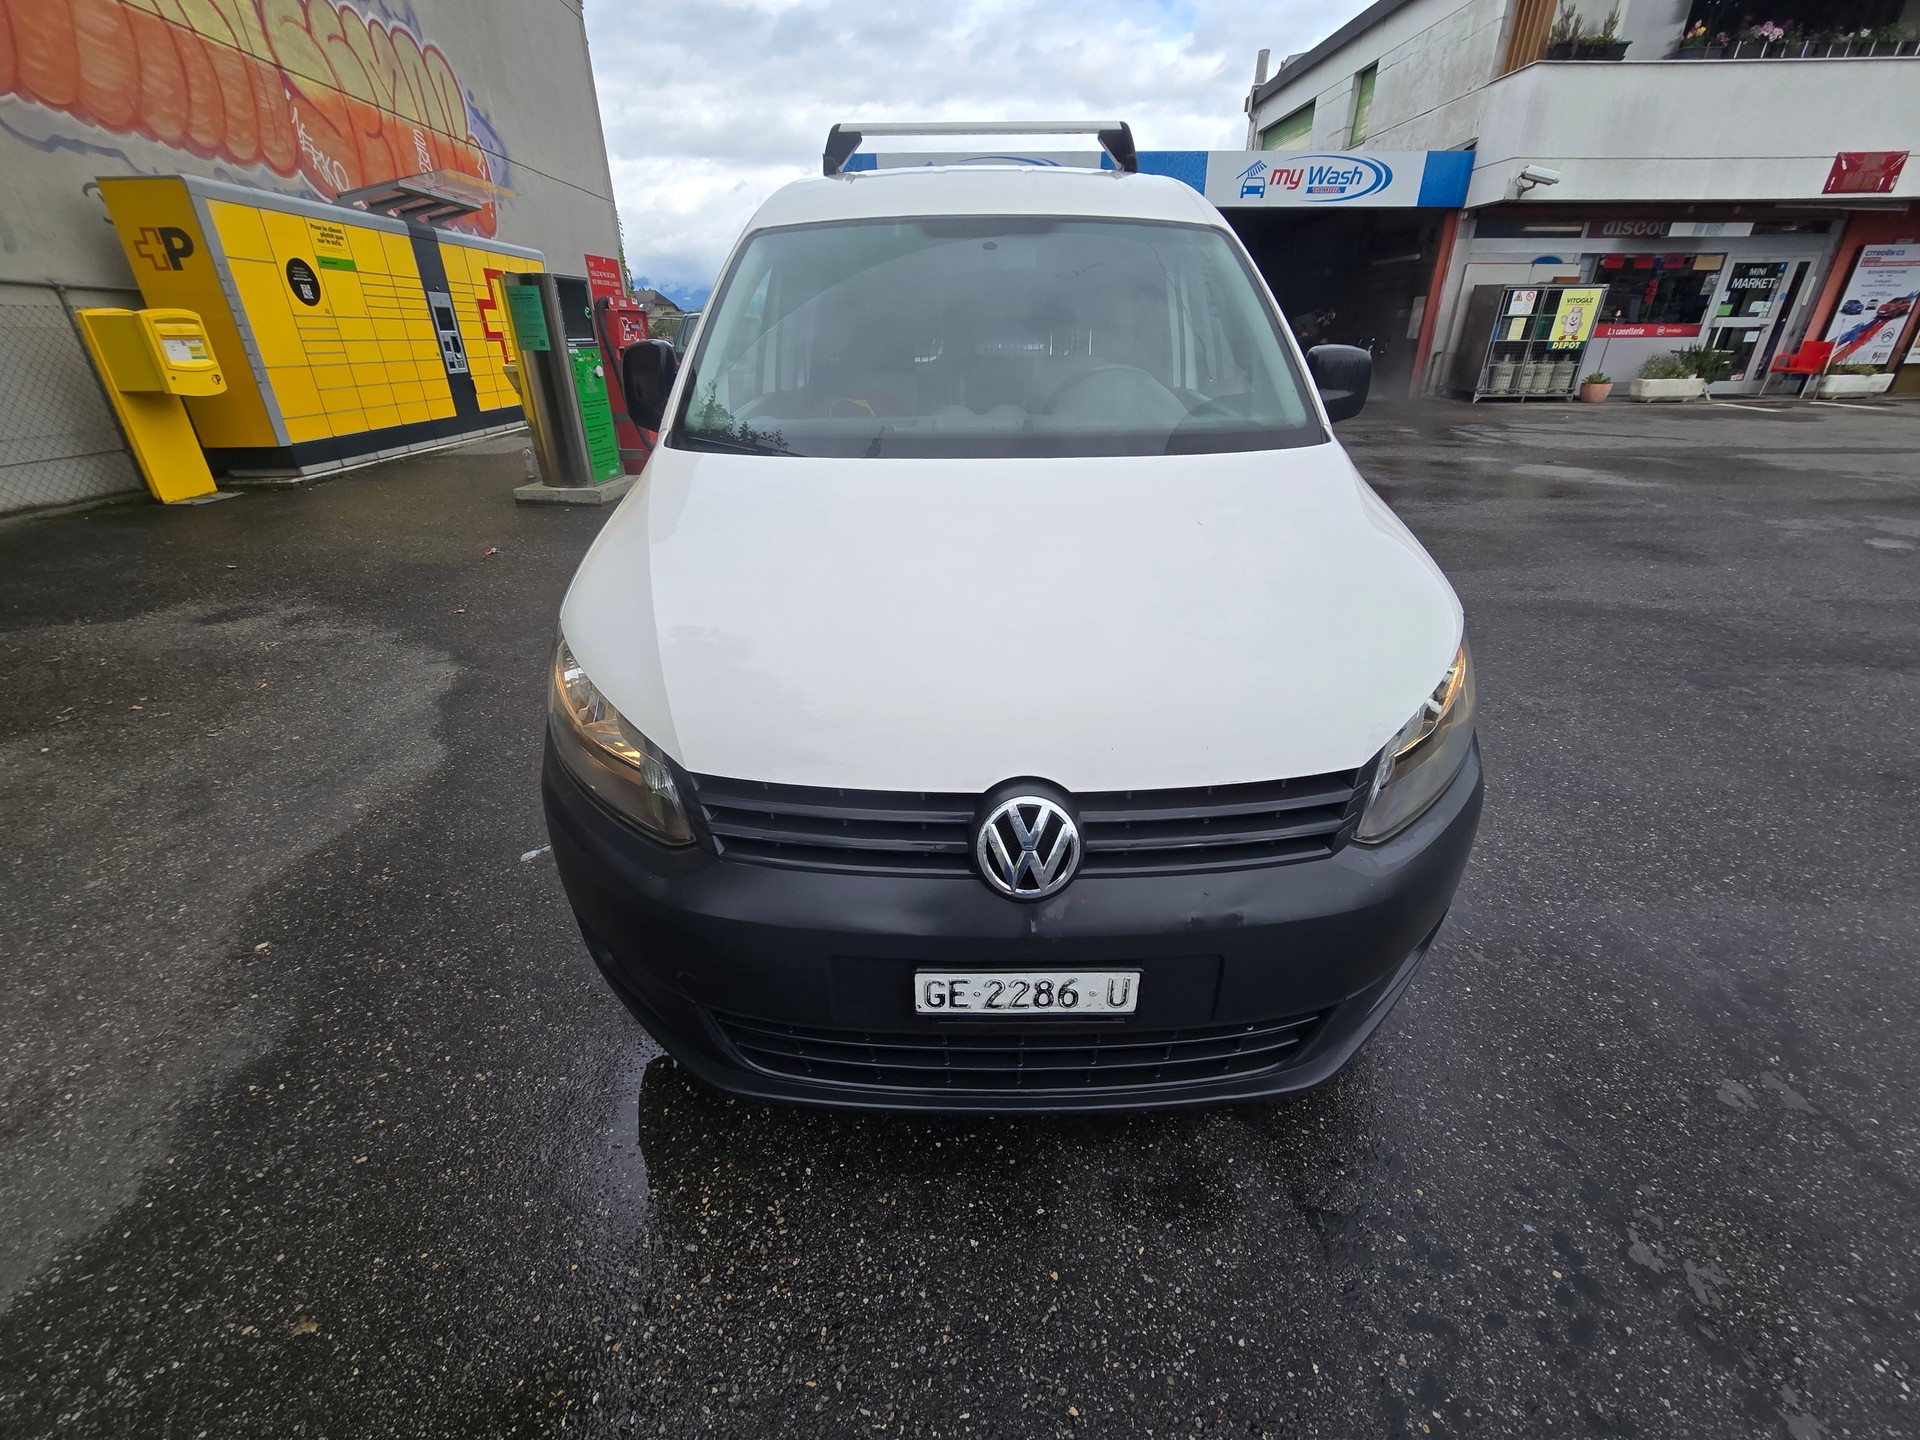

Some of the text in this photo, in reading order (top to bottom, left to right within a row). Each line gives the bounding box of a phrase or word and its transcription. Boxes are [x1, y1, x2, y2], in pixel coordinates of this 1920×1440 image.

[1269, 166, 1363, 190] my Wash
[1749, 267, 1767, 276] MINI
[1731, 277, 1776, 289] MARKET
[1551, 341, 1581, 350] DEPOT
[924, 977, 1131, 1010] GE 2286 U
